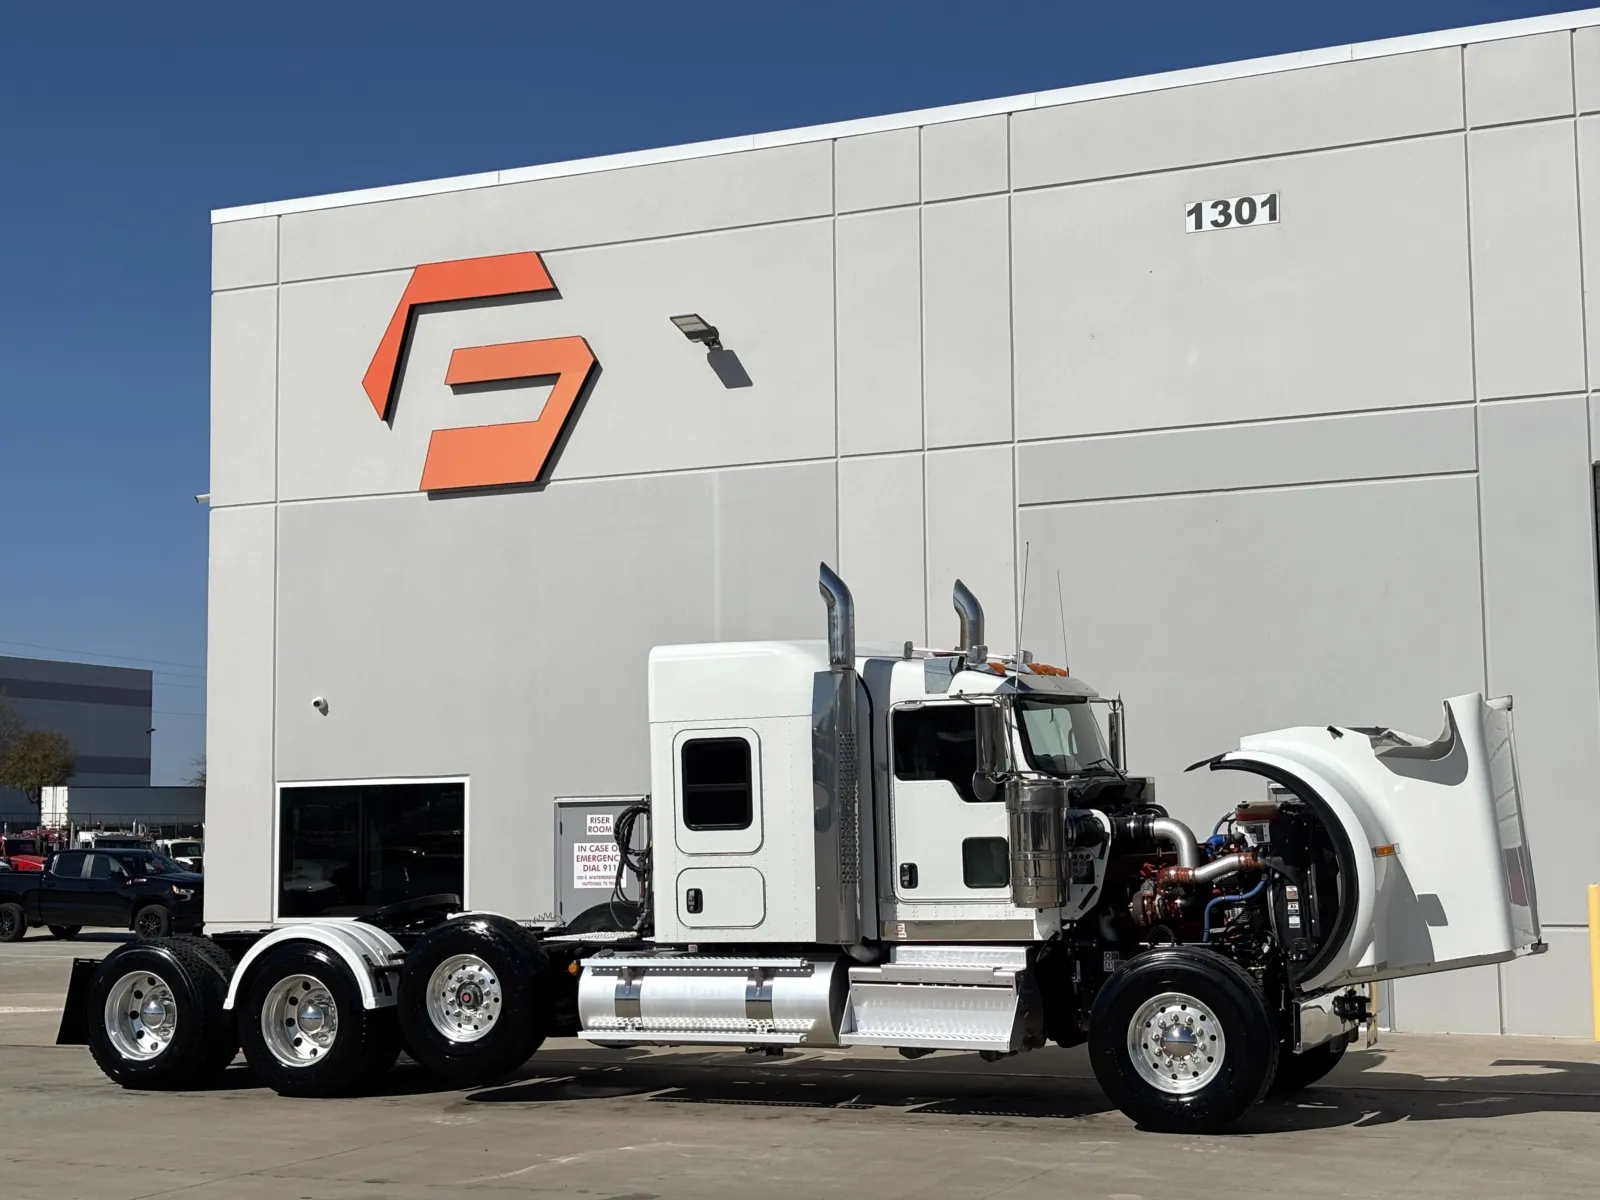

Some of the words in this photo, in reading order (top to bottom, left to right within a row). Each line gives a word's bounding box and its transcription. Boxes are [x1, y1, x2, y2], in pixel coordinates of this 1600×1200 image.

[1186, 193, 1277, 230] 1301
[590, 816, 610, 824] RISER
[588, 825, 612, 833] ROOM
[578, 845, 587, 853] IN
[589, 844, 609, 852] CASE
[611, 844, 618, 852] O
[576, 854, 620, 862] EMERGENC
[583, 864, 601, 872] DIAL
[603, 864, 617, 872] 911
